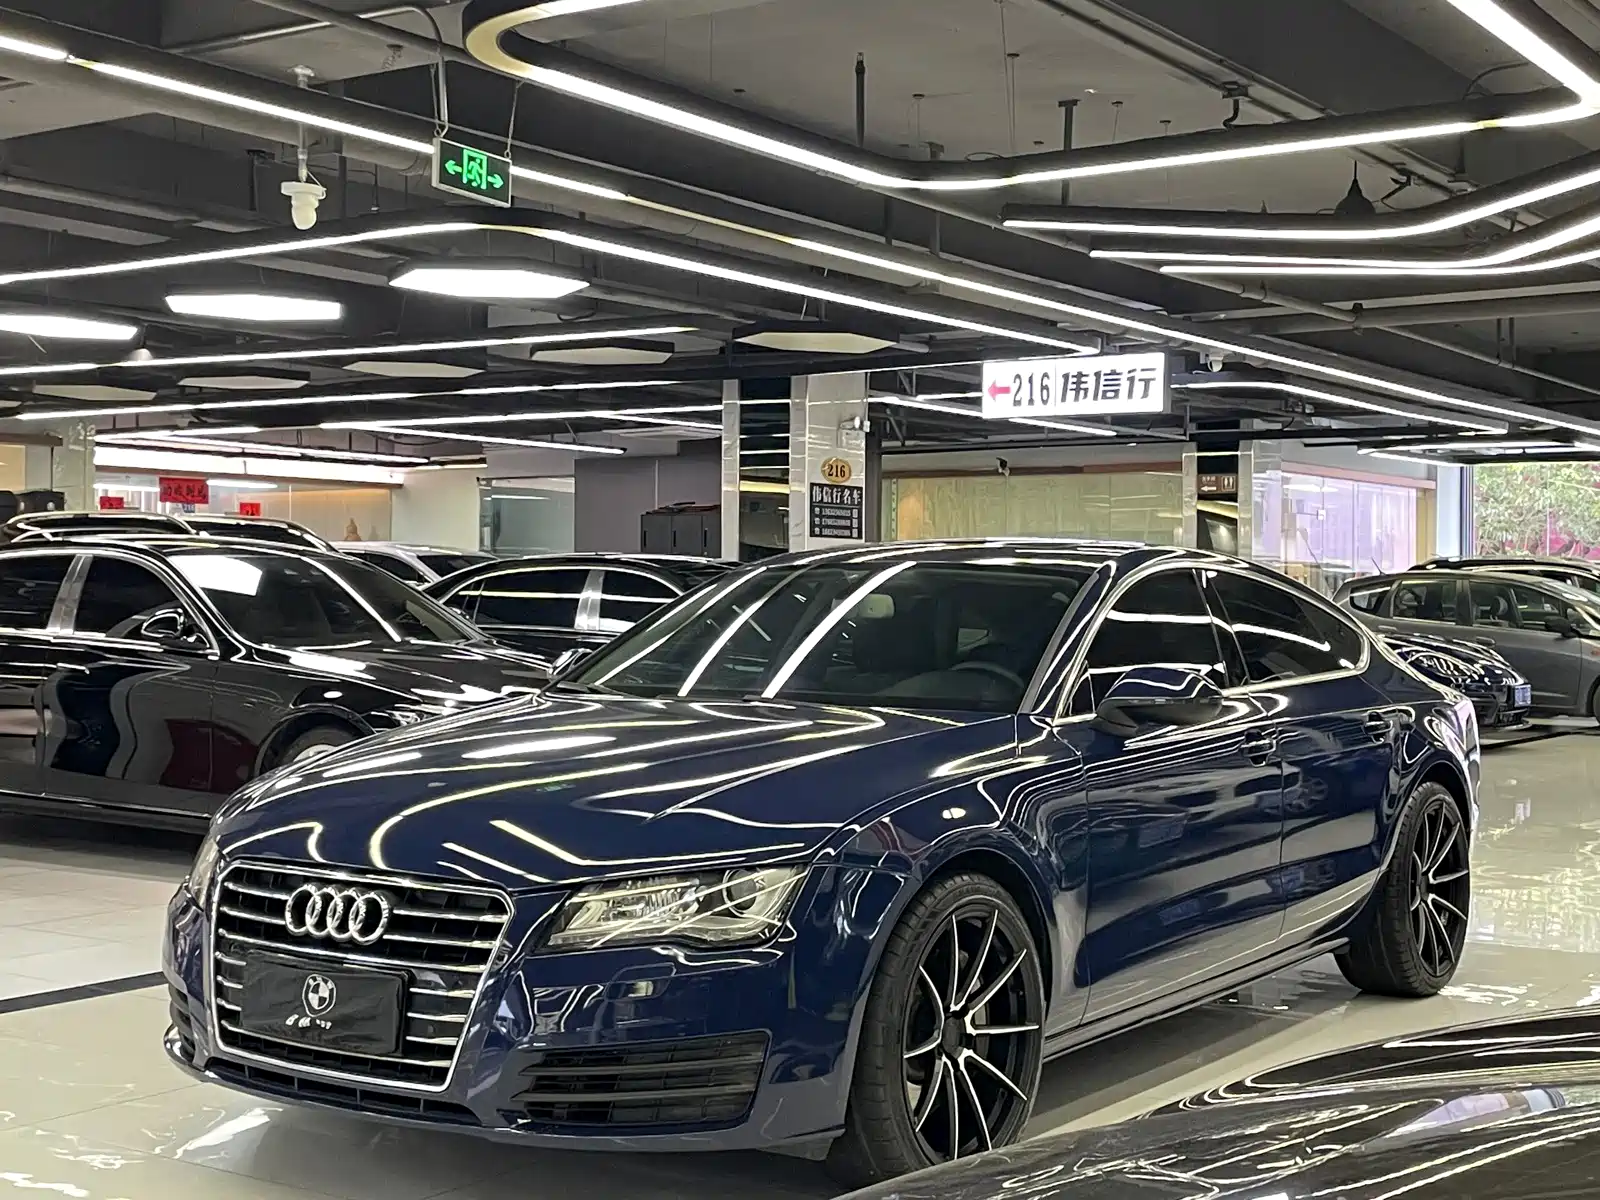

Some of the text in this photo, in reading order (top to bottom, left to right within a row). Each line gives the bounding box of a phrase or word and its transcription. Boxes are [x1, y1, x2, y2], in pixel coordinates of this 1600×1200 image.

[1013, 368, 1156, 406] 216 伟信行
[828, 464, 845, 478] 216
